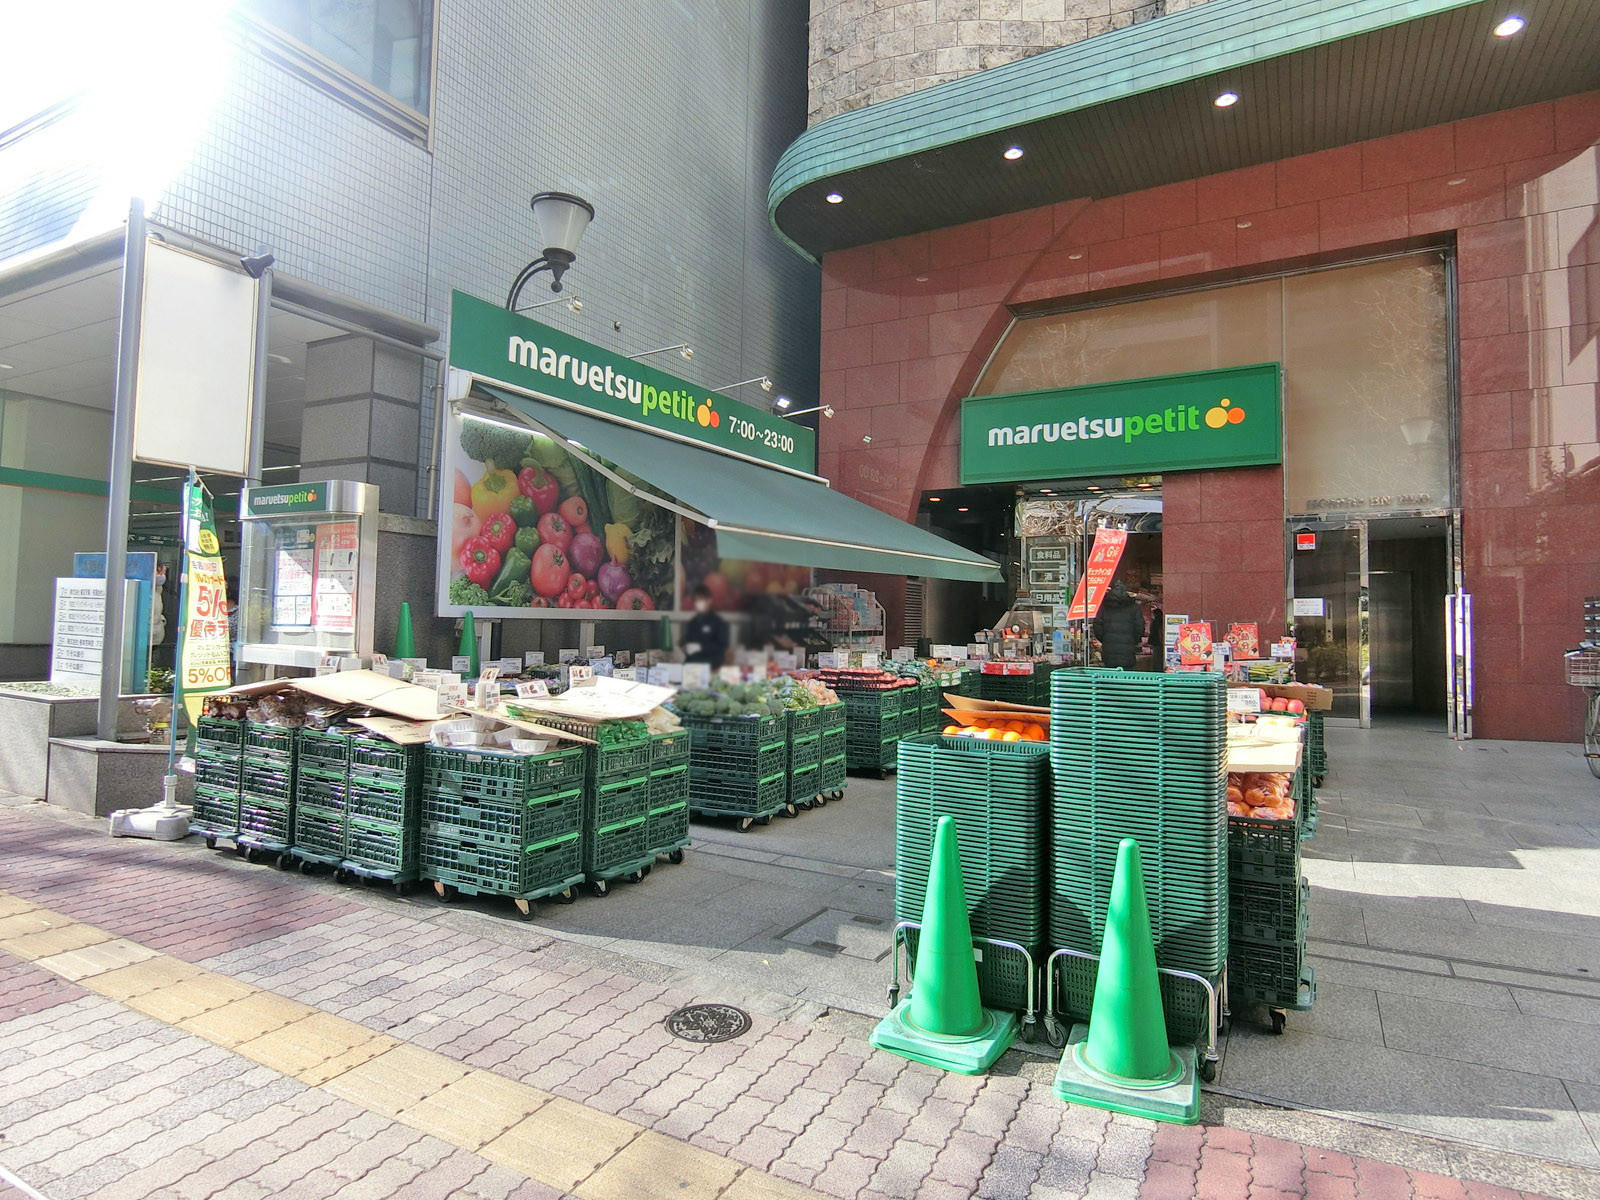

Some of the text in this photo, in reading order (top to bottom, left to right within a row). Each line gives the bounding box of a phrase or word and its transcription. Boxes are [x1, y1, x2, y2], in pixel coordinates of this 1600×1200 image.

[1036, 550, 1061, 560] 食料品
[1044, 571, 1053, 581] 酒
[1036, 593, 1061, 603] 日用品
